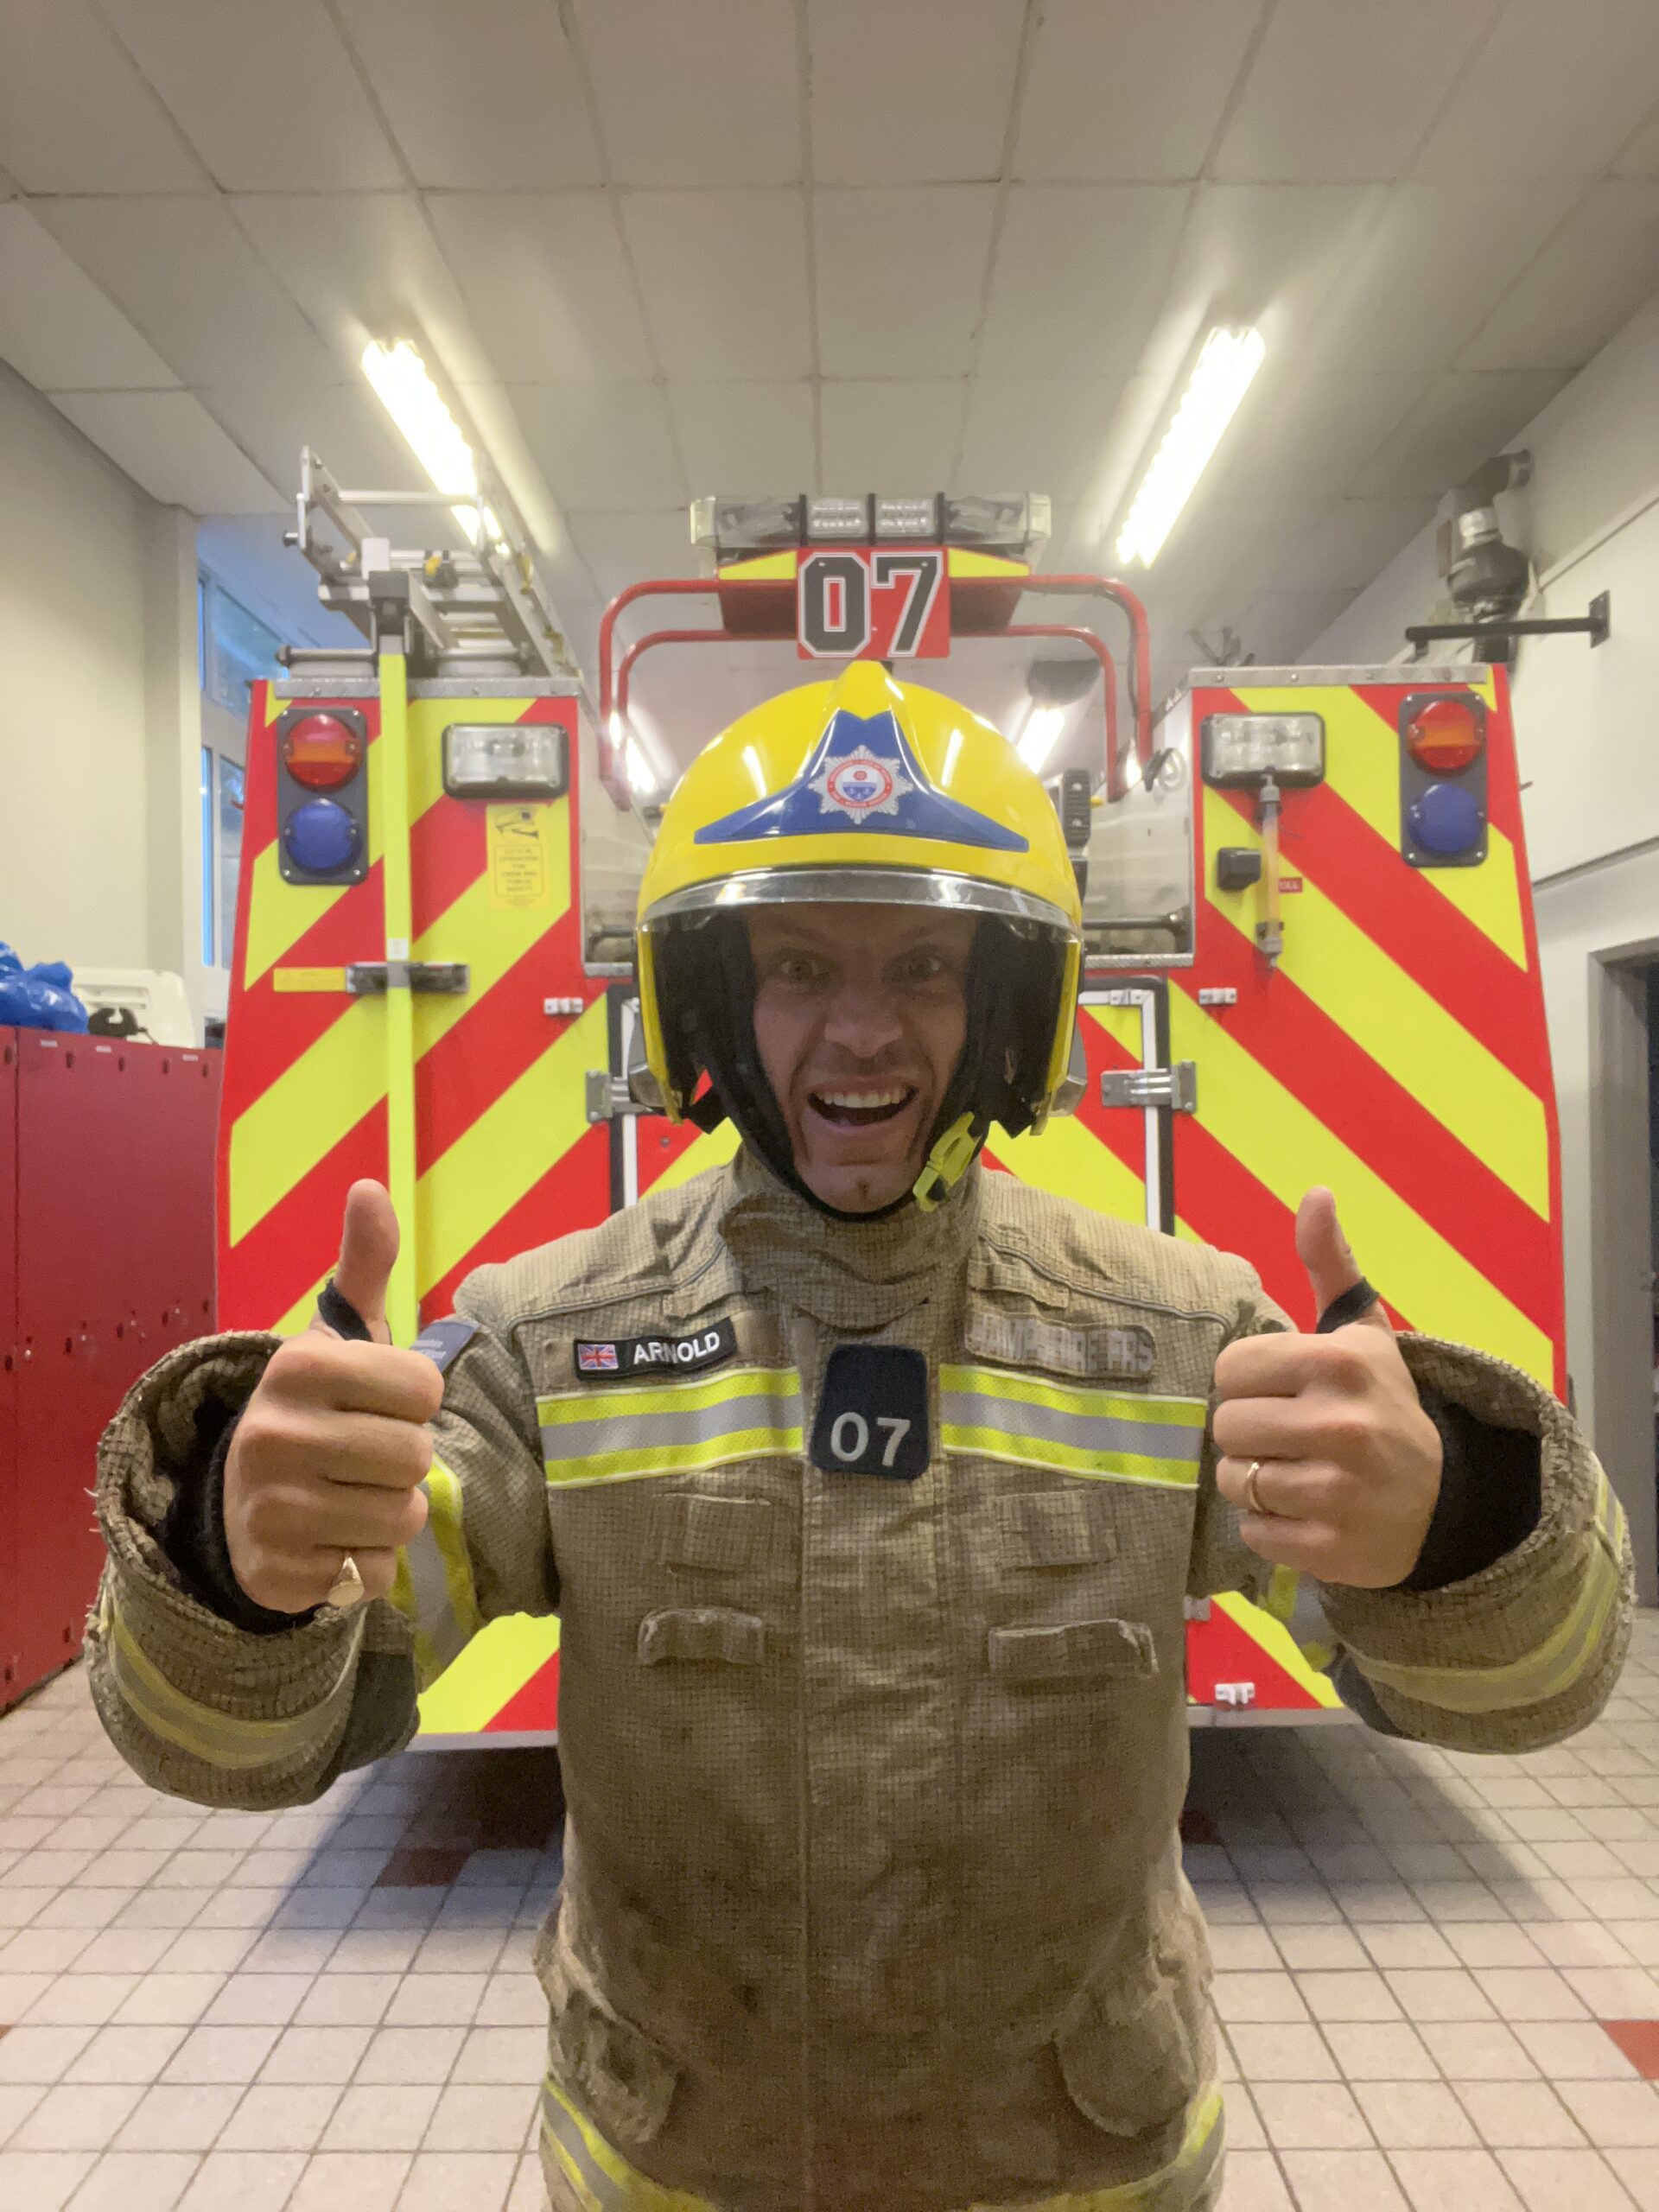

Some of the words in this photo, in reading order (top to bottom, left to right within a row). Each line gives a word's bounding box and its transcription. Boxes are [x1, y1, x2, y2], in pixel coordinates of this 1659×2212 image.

[798, 552, 943, 657] 07
[632, 1332, 721, 1365] ARNOLD
[830, 1411, 912, 1466] 07
